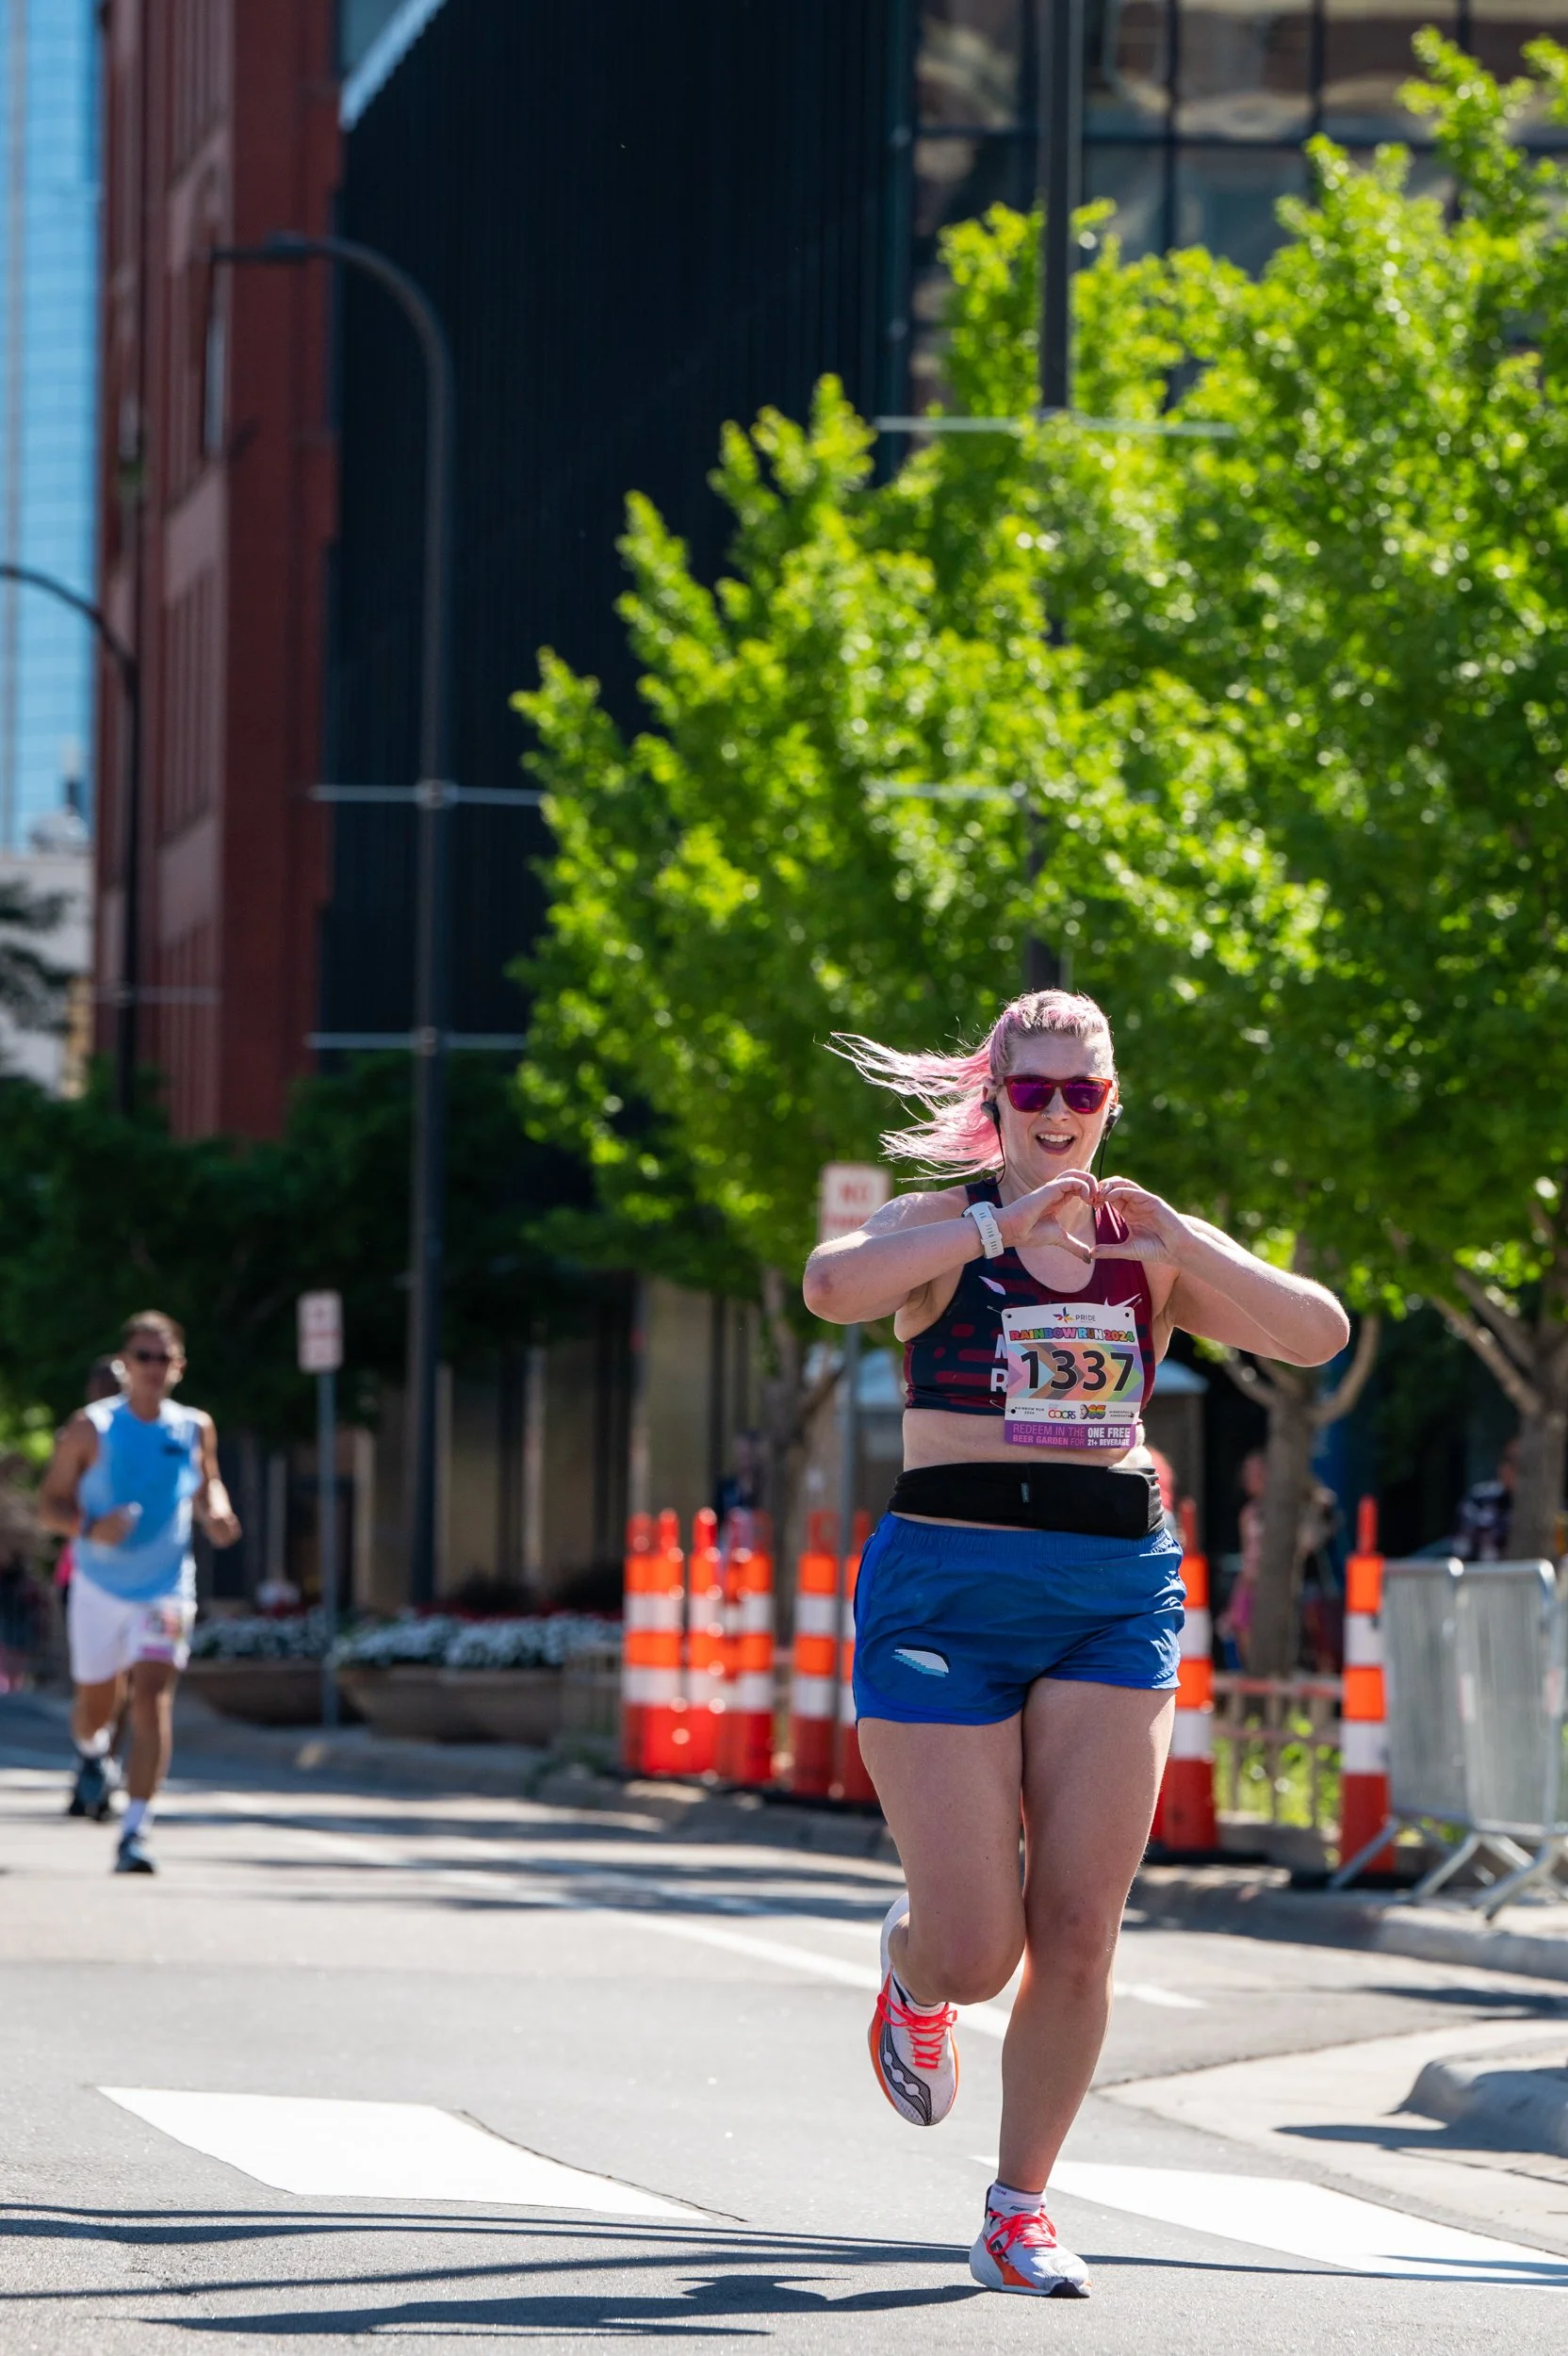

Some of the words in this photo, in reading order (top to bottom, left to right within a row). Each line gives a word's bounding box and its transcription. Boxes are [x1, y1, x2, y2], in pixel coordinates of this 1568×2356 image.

[1009, 1327, 1076, 1341] RAINBOW
[1077, 1327, 1103, 1340] RUN
[1103, 1330, 1135, 1342] 2024
[1021, 1350, 1135, 1391] 1337
[1013, 1424, 1053, 1435] REDEEM
[1055, 1426, 1066, 1436] IN
[1069, 1427, 1085, 1437] THE
[1087, 1427, 1105, 1438] ONE
[1107, 1427, 1131, 1438] FREE
[1012, 1434, 1034, 1443] BEER
[1037, 1435, 1069, 1446] GARDEN
[1070, 1438, 1085, 1447] FOR
